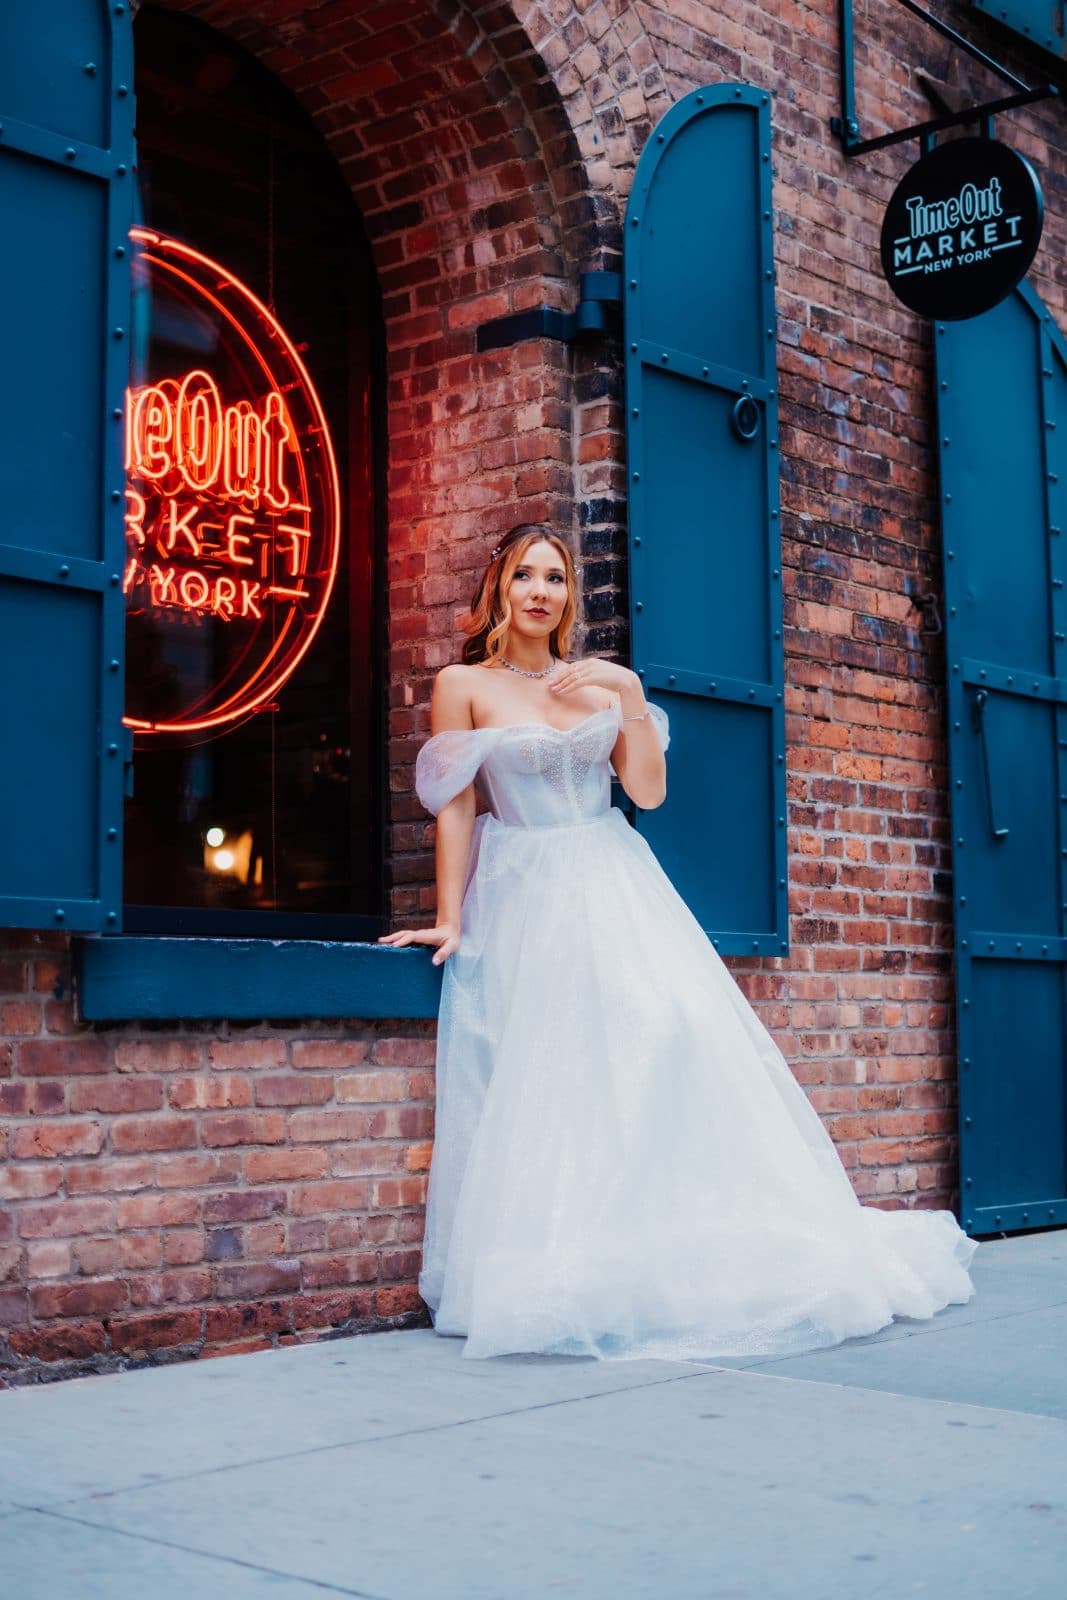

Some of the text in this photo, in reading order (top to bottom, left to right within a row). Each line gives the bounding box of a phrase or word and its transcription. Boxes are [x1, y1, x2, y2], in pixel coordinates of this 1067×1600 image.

[894, 216, 1022, 267] MARKET
[924, 247, 992, 274] NEW YORK
[152, 564, 262, 619] YORK
